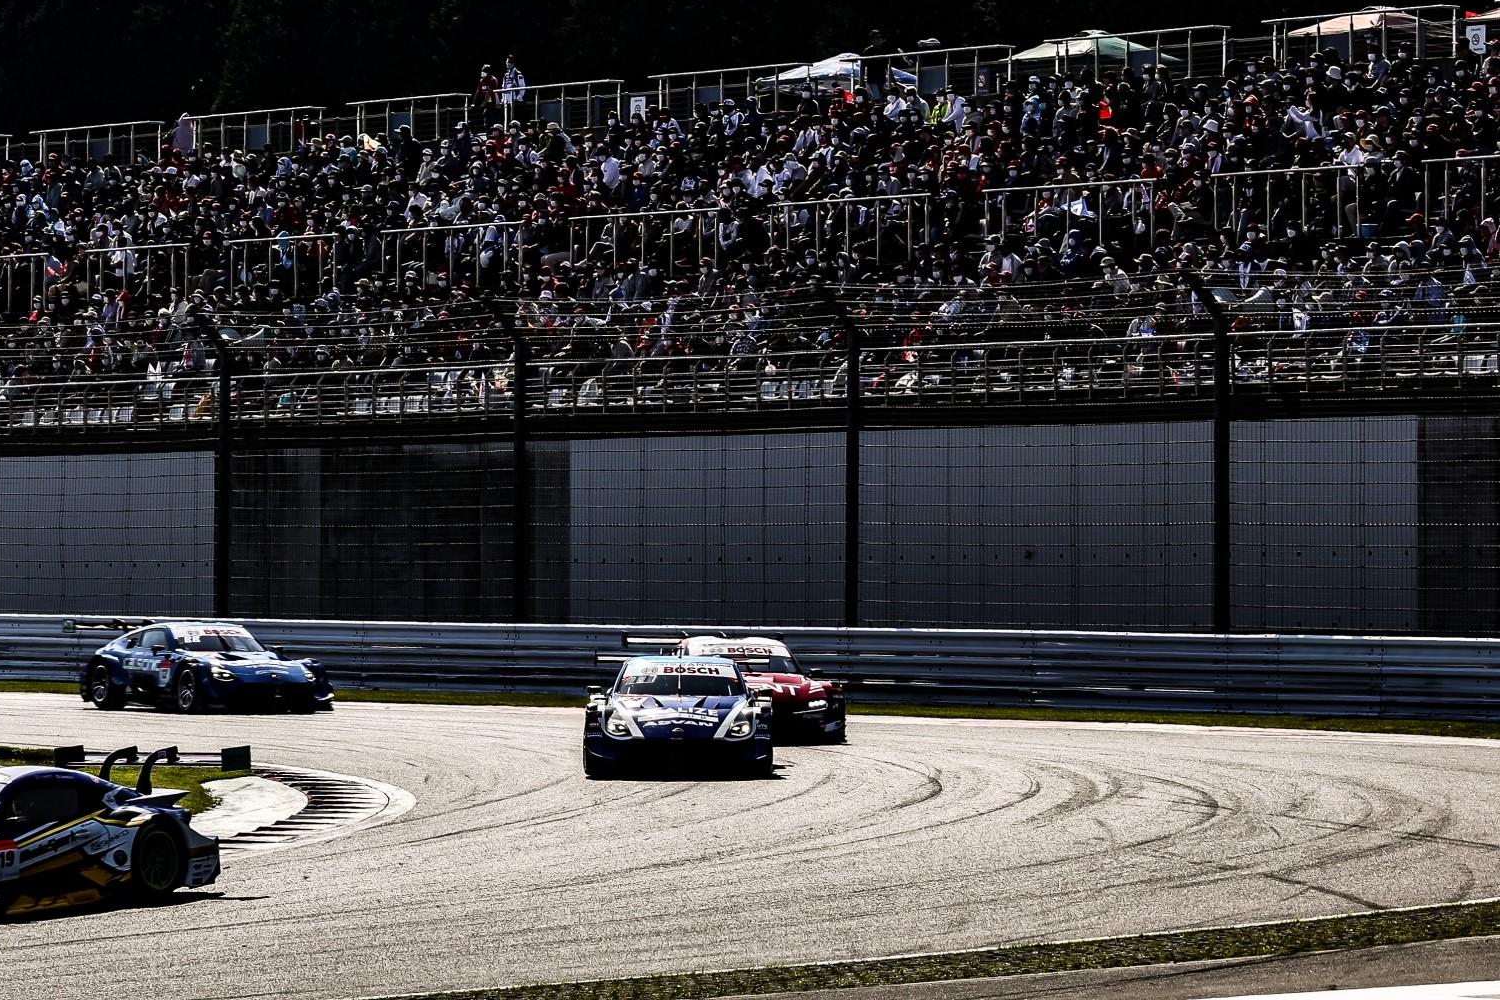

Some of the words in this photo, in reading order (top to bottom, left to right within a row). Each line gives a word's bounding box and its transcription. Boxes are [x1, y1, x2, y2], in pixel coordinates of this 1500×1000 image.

[663, 666, 721, 675] BOSCH
[638, 707, 719, 717] ALIZE
[642, 719, 714, 727] ADVAN
[0, 850, 15, 869] 19
